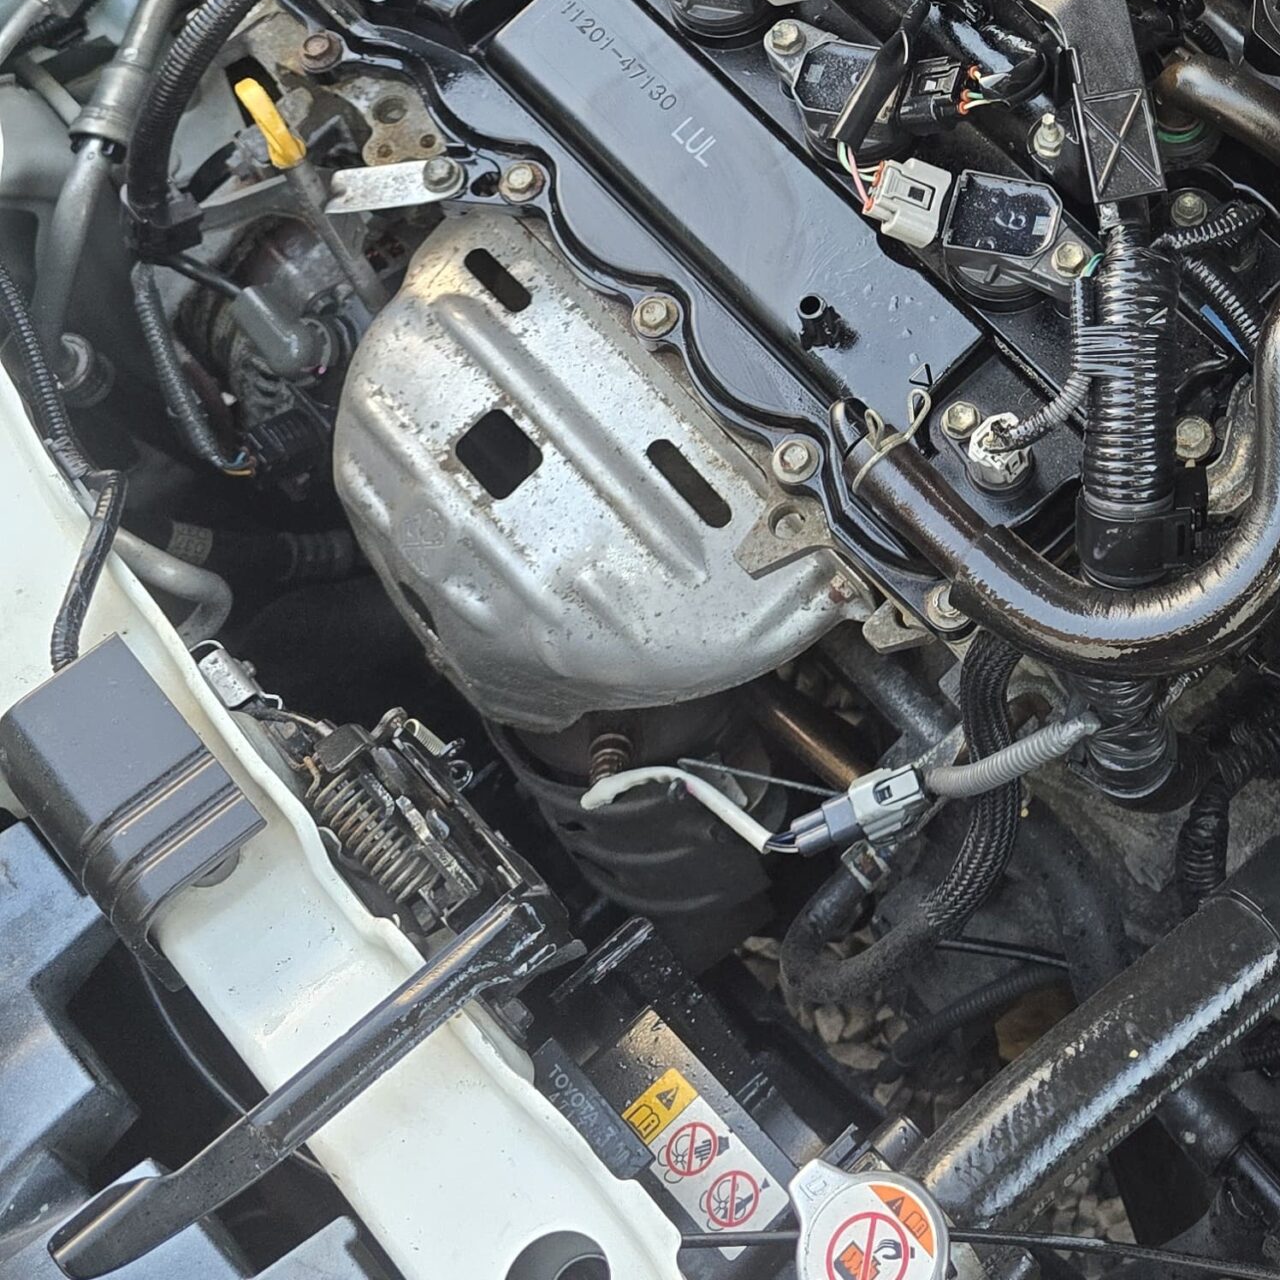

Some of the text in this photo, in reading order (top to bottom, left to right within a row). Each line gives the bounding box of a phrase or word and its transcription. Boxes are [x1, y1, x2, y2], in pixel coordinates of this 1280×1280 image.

[561, 0, 677, 110] 11201-47130
[671, 116, 717, 168] LUL
[548, 1063, 600, 1126] TOYOTA
